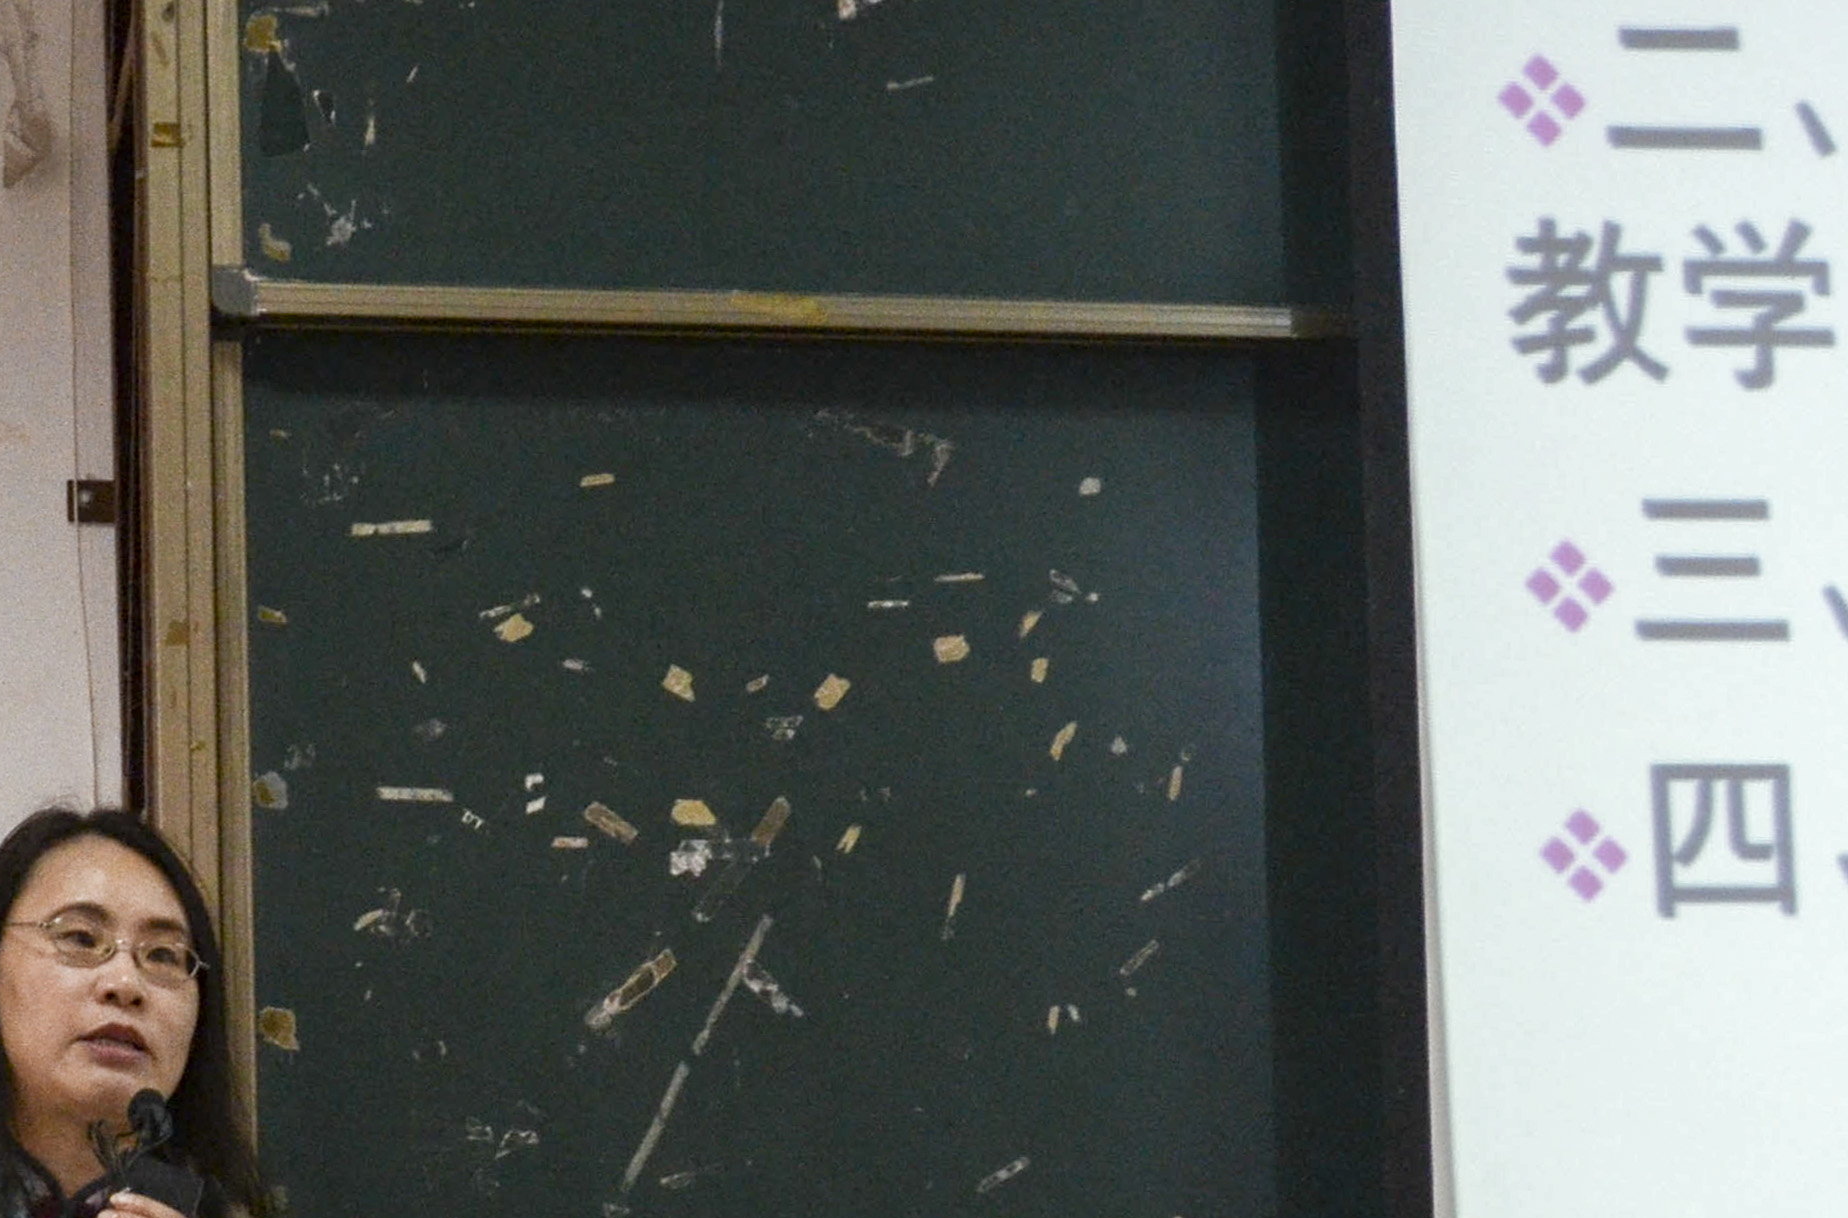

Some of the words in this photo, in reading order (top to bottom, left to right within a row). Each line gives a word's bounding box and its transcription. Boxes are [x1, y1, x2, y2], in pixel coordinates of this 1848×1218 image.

[1607, 25, 1837, 158] 二、
[1505, 216, 1837, 390] 教学
[1650, 763, 1848, 919] 四
